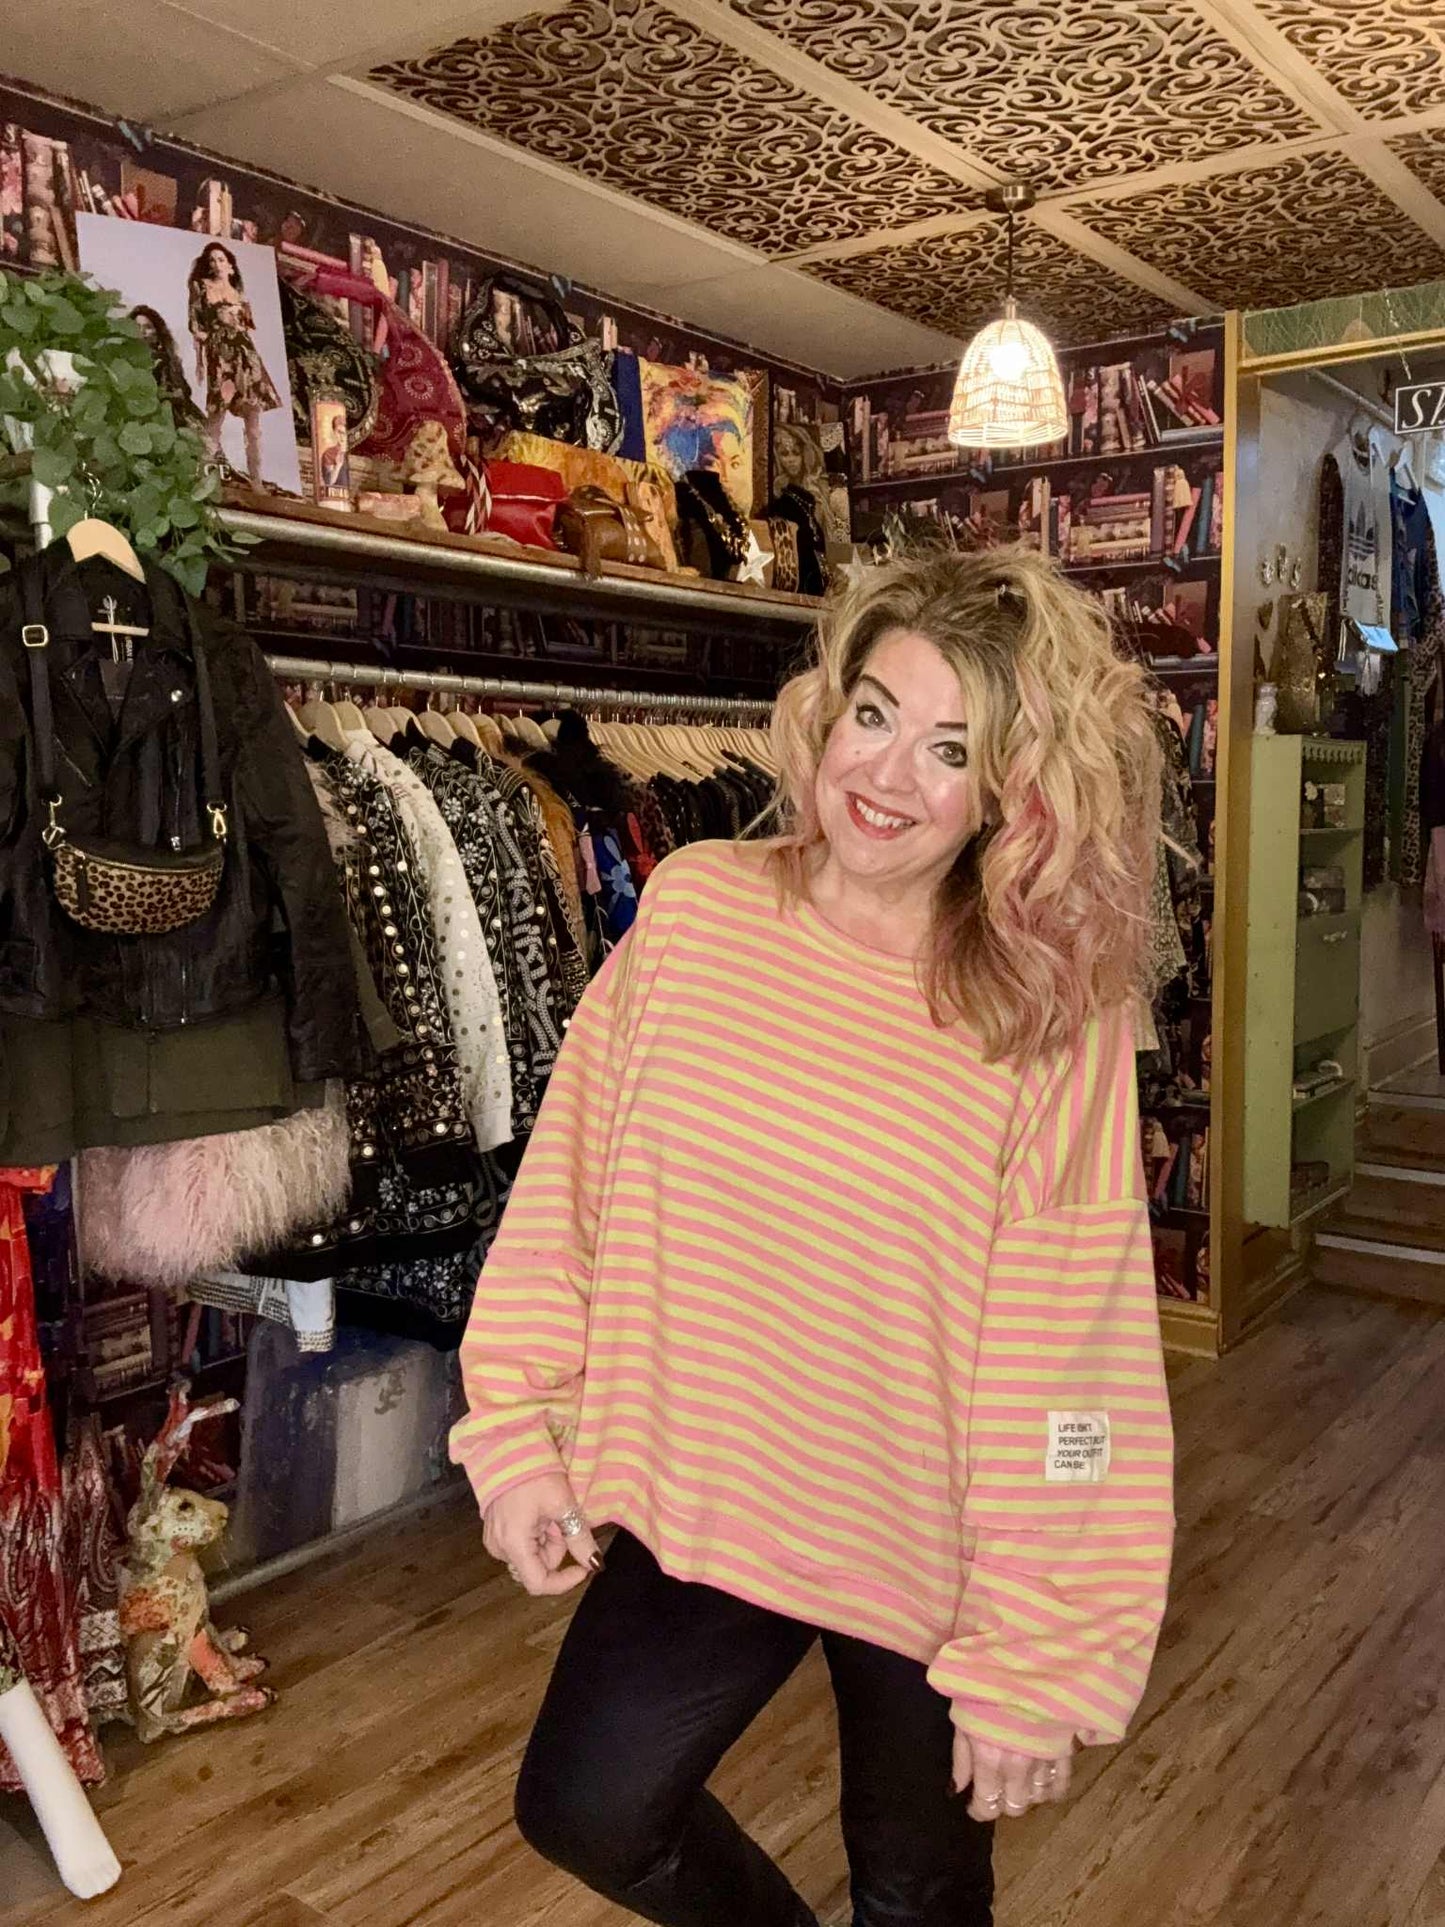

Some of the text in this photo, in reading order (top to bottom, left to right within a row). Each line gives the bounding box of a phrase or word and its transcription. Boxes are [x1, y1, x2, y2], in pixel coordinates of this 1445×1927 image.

[1058, 1423, 1076, 1433] LIFE
[1058, 1436, 1092, 1446] PERFECT
[1057, 1449, 1081, 1458] YOUR
[1054, 1460, 1072, 1469] CAN
